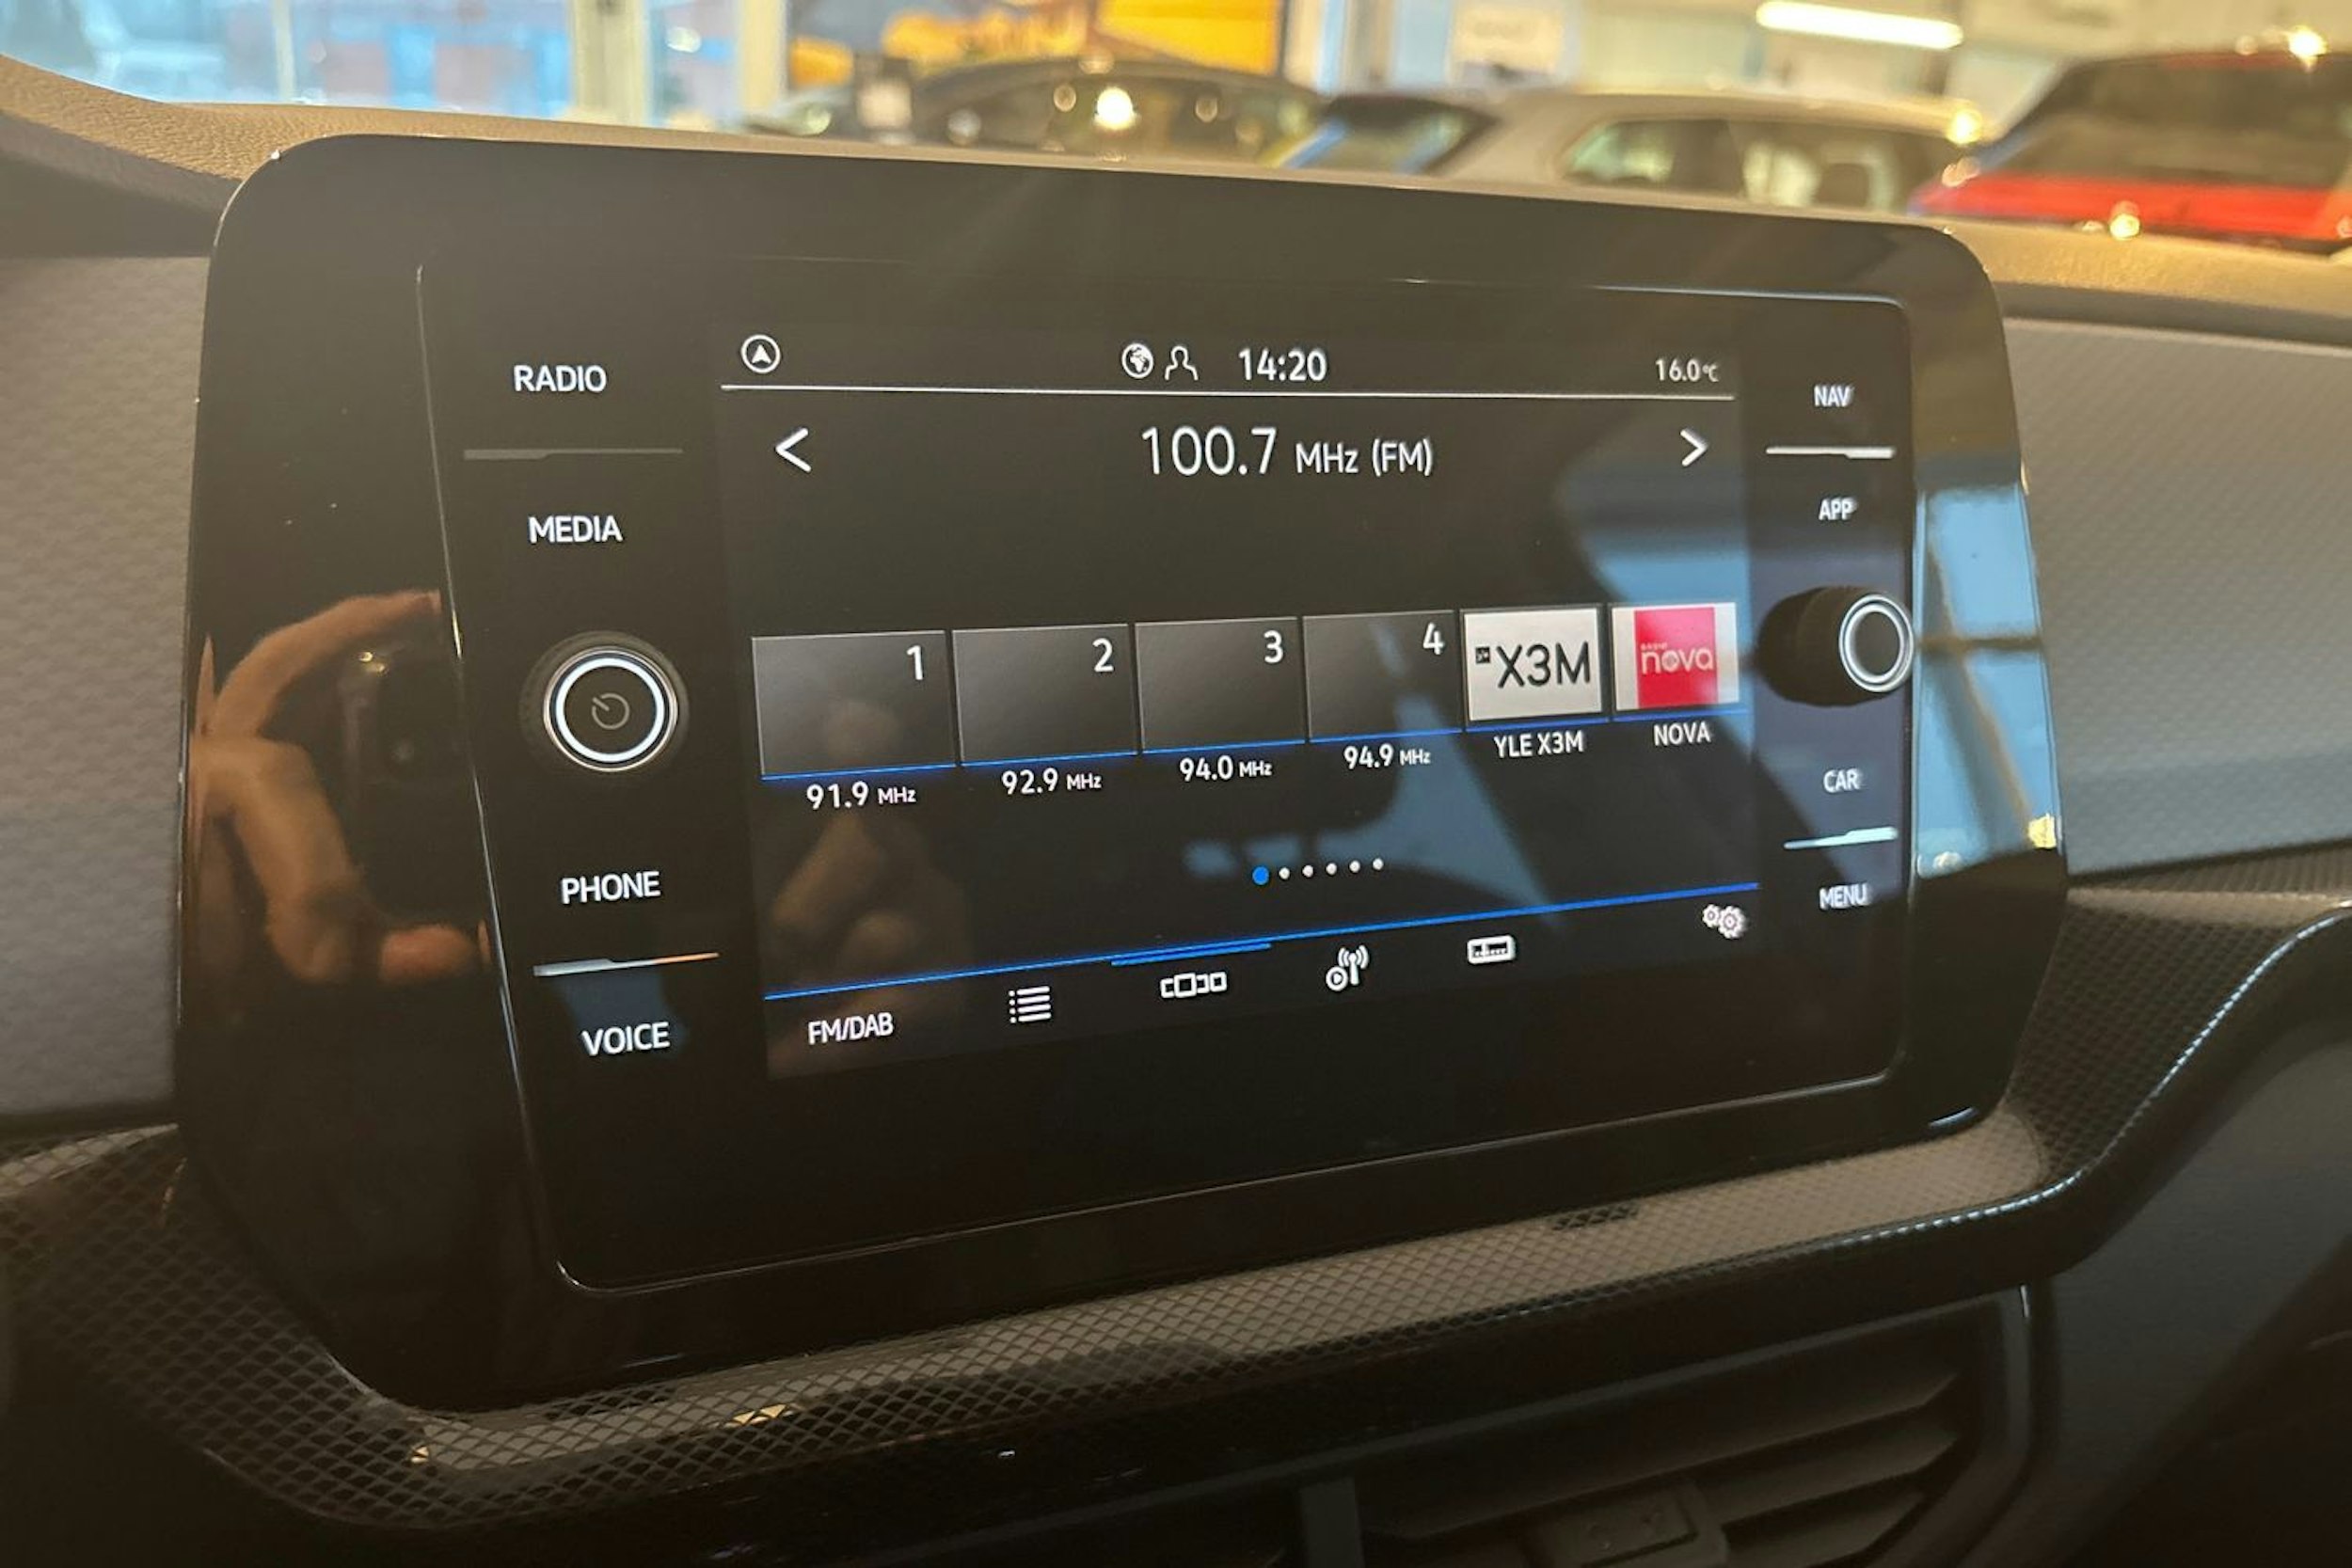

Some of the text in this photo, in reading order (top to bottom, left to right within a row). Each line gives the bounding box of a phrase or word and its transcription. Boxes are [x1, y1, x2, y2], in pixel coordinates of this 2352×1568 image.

[513, 364, 607, 393] RADIO
[1238, 348, 1327, 381] 14:20
[1813, 384, 1852, 407] NAV
[1141, 425, 1434, 477] 100.7 MHz (FM)
[1819, 498, 1855, 521] APP
[528, 515, 623, 544] MEDIA
[1263, 630, 1284, 663] 3
[1422, 623, 1444, 655] 4
[906, 645, 924, 680] 1
[1092, 638, 1115, 673] 2
[1497, 641, 1591, 688] X3M
[1641, 647, 1713, 675] nova
[1494, 730, 1584, 758] YLE X3M
[1653, 721, 1711, 746] NOVA
[1179, 755, 1273, 783] 94.0 MHz
[1343, 743, 1432, 769] 94.9 MHz
[1001, 767, 1103, 796] 92.9 MHz
[1822, 768, 1862, 793] CAR
[806, 781, 917, 810] 91.9 MHz
[561, 870, 661, 905] PHONE
[1819, 882, 1868, 910] MENU
[580, 1021, 672, 1057] VOICE
[807, 1011, 895, 1046] FM/DAB
